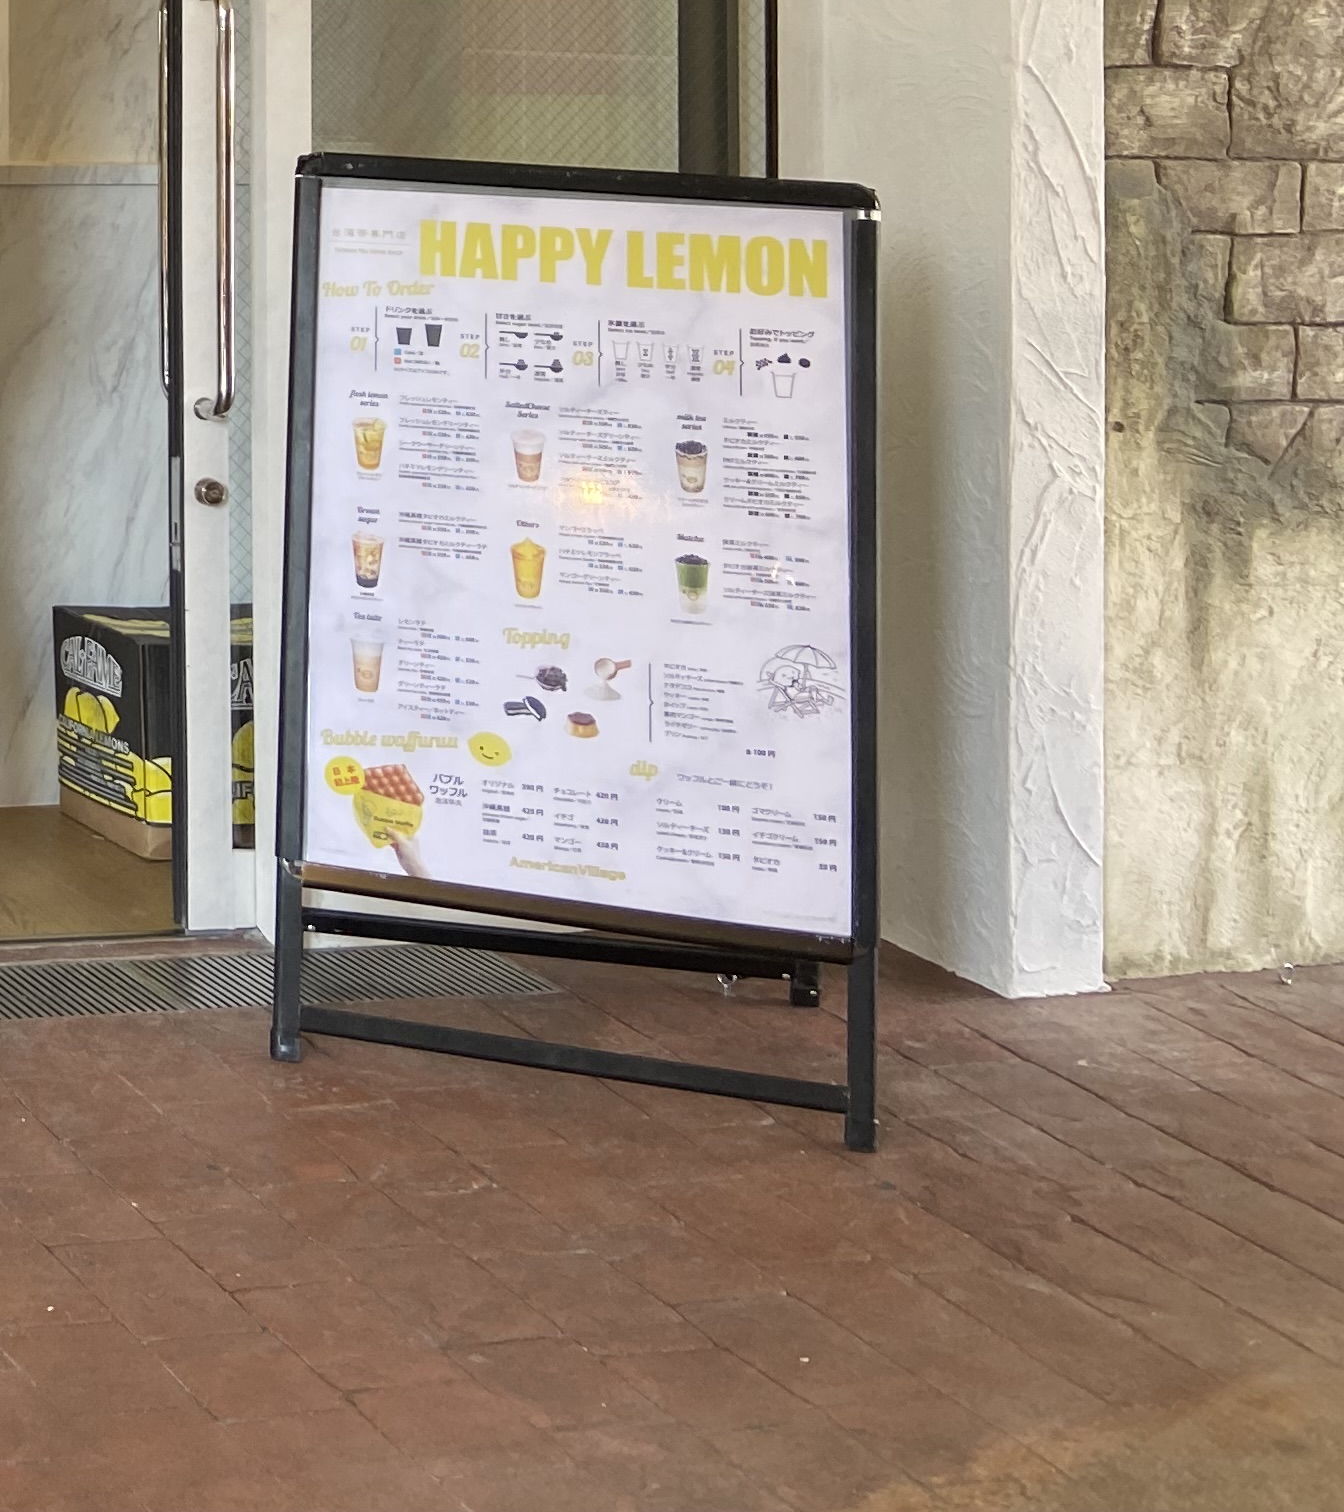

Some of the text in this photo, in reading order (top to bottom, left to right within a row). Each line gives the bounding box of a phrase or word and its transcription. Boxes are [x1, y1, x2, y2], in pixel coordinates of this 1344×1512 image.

[419, 219, 828, 298] HAPPY LEMON
[322, 280, 434, 297] How To Order
[350, 336, 368, 351] 01
[460, 343, 480, 359] 02
[712, 360, 735, 375] 04
[503, 627, 570, 649] Topping
[95, 730, 130, 754] LEMONS
[321, 729, 377, 746] Bubble
[429, 785, 468, 798] ワッフル
